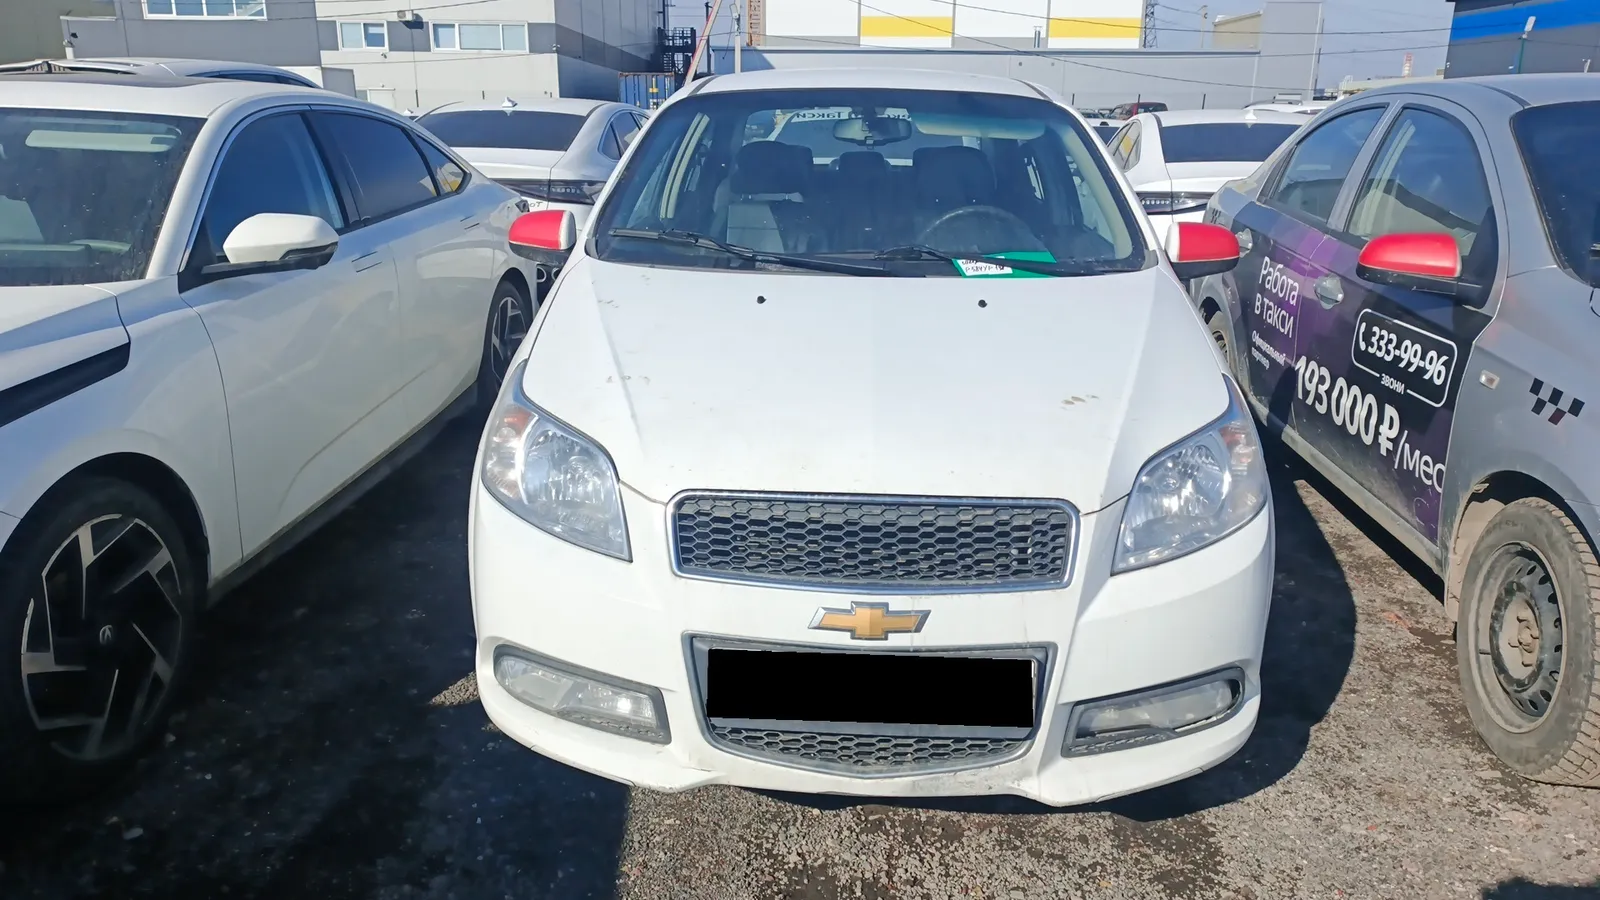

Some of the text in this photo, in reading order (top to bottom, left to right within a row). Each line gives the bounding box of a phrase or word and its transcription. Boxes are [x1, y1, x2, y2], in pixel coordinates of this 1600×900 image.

[1259, 256, 1299, 306] Работа
[1263, 297, 1294, 338] такси
[1367, 326, 1449, 385] 333-99-96
[1295, 355, 1331, 414] 193
[1331, 377, 1378, 445] 000
[1381, 373, 1405, 395] ЗВОНИ
